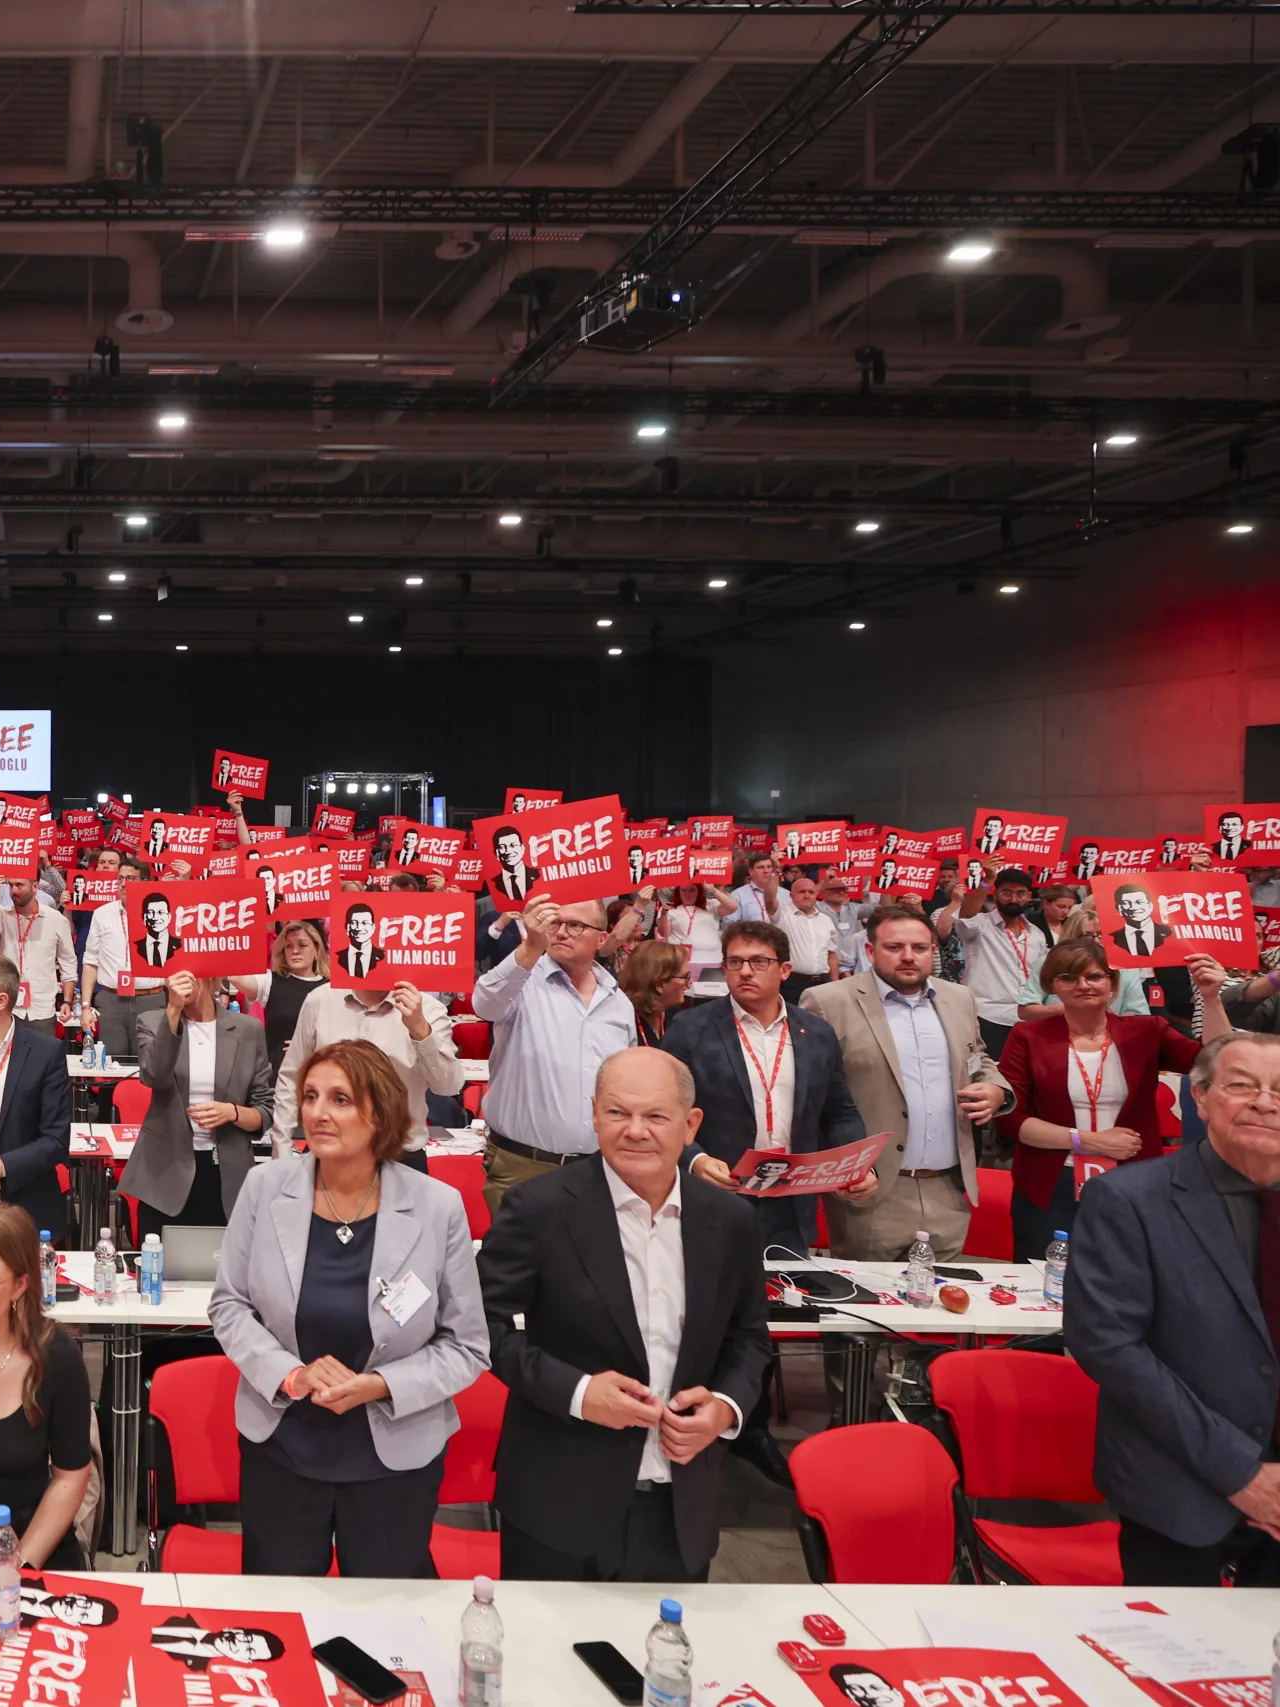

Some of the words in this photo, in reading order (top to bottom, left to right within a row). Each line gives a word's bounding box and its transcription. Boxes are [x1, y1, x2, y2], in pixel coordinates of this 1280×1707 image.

[230, 764, 264, 780] FREE
[232, 777, 259, 789] IMAMOGLU
[5, 805, 38, 820] FREE
[329, 815, 352, 826] FREE
[701, 821, 730, 831] FREE
[40, 826, 54, 838] EE
[78, 826, 100, 838] FREE
[166, 827, 211, 843] FREE
[258, 831, 282, 841] FREE
[631, 829, 658, 839] FREE
[1003, 825, 1060, 842] FREE
[1247, 818, 1280, 840] FR
[120, 832, 140, 843] FREE
[528, 816, 612, 867] FREE
[801, 829, 841, 845] FREE
[57, 845, 74, 856] REE
[169, 844, 204, 855] IMAMOGLU
[418, 837, 460, 855] FREE
[897, 839, 932, 853] FREE
[1006, 841, 1050, 853] IMAMOGLU
[420, 854, 453, 866] IMAMOGLU
[645, 844, 686, 867] FREE
[850, 848, 876, 861] FREE
[1100, 849, 1155, 866] FREE
[209, 856, 237, 870] FREE
[541, 855, 611, 882] IMAMOGLU
[696, 856, 729, 868] FREE
[649, 864, 682, 875] IMAMOGLU
[896, 866, 936, 881] FREE
[278, 864, 333, 893] FREE
[842, 876, 860, 885] REE
[898, 879, 929, 889] IMAMOGLU
[85, 879, 118, 899] FREE
[85, 893, 118, 906] IMAMOGLU
[285, 890, 330, 903] IMAMOGLU
[1158, 890, 1243, 924] FREE
[175, 897, 257, 936] FREE
[380, 911, 464, 946] FREE
[1173, 925, 1242, 942] IMAMOGLU
[183, 936, 250, 953] IMAMOGLU
[386, 949, 456, 966] IMAMOGLU
[121, 975, 130, 986] D
[1152, 989, 1161, 999] D
[788, 1144, 884, 1180] FREE
[790, 1172, 868, 1188] IMAMOGLU
